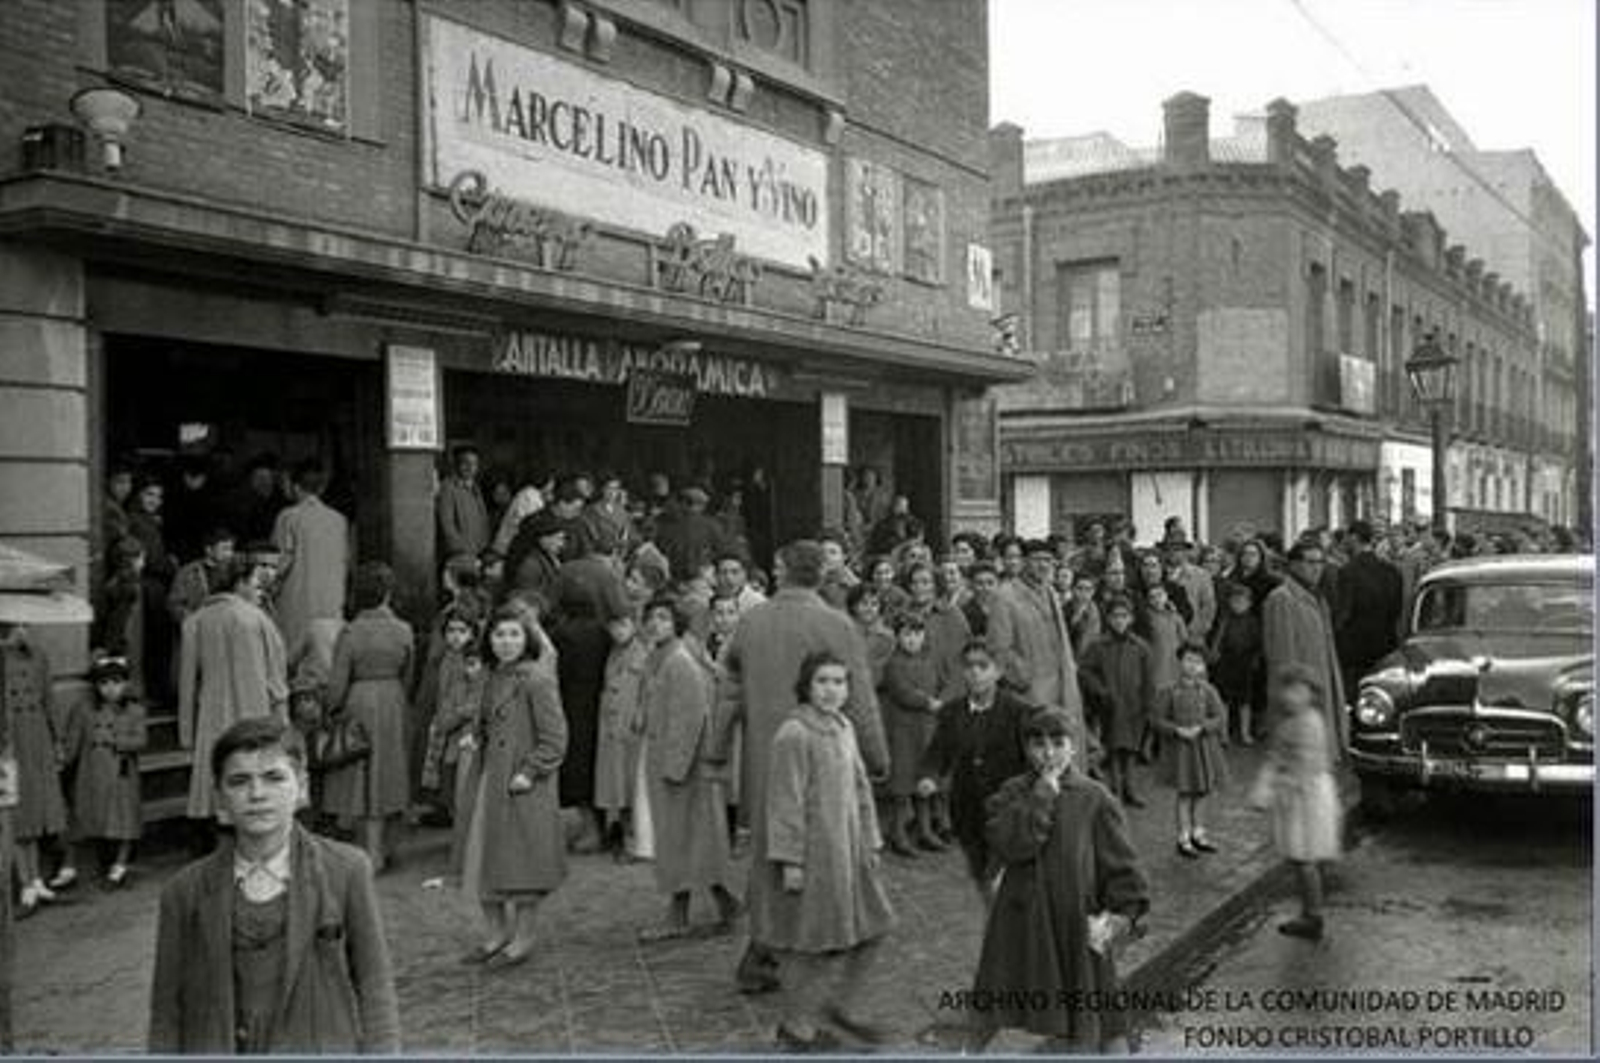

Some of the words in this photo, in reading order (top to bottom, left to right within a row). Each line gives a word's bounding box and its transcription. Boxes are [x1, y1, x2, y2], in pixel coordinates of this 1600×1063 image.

[459, 50, 671, 181] MARCELINO
[681, 124, 738, 201] PAN
[762, 156, 817, 230] VINO
